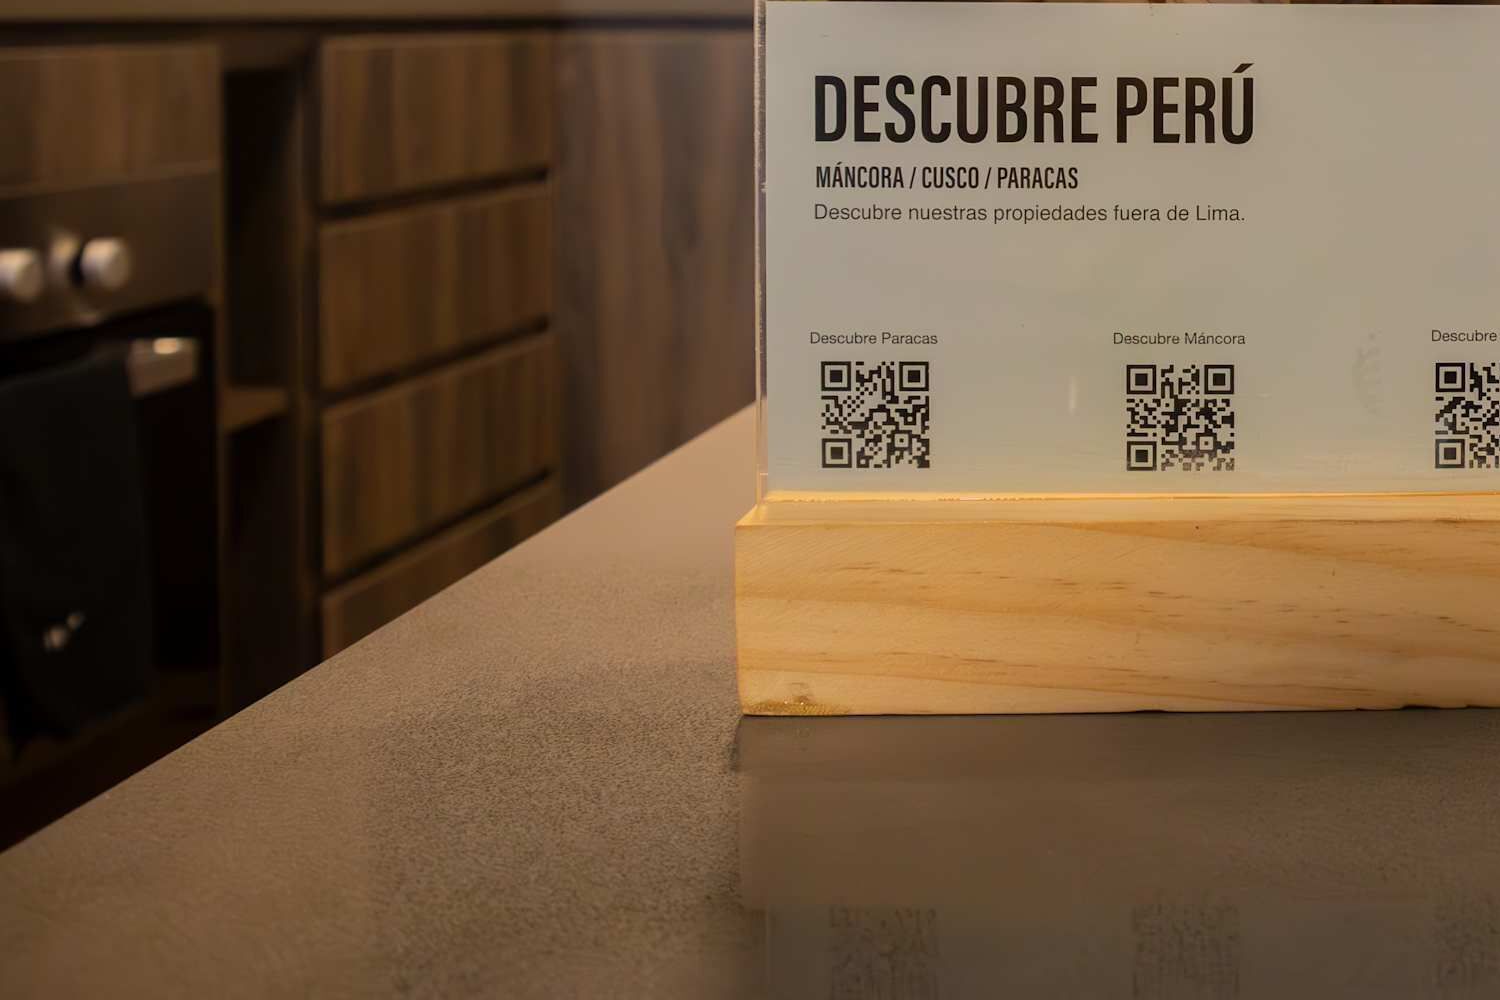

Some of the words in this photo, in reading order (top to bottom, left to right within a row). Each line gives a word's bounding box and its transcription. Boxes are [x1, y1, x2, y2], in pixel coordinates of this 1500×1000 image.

[815, 75, 1099, 144] DESCUBRE
[1116, 63, 1255, 144] PERÚ
[815, 161, 904, 189] MÁNCORA
[921, 166, 979, 189] CUSCO
[997, 166, 1079, 190] PARACAS
[814, 203, 902, 221] Descubre
[908, 205, 987, 222] nuestras
[993, 204, 1108, 225] propiedades
[1113, 204, 1161, 221] fuera
[1166, 205, 1190, 222] de
[1196, 205, 1246, 222] Lima.
[809, 332, 877, 345] Descubre
[881, 333, 938, 345] Paracas
[1112, 332, 1180, 345] Descubre
[1184, 332, 1246, 345] Máncora
[1431, 329, 1498, 342] Descubre
